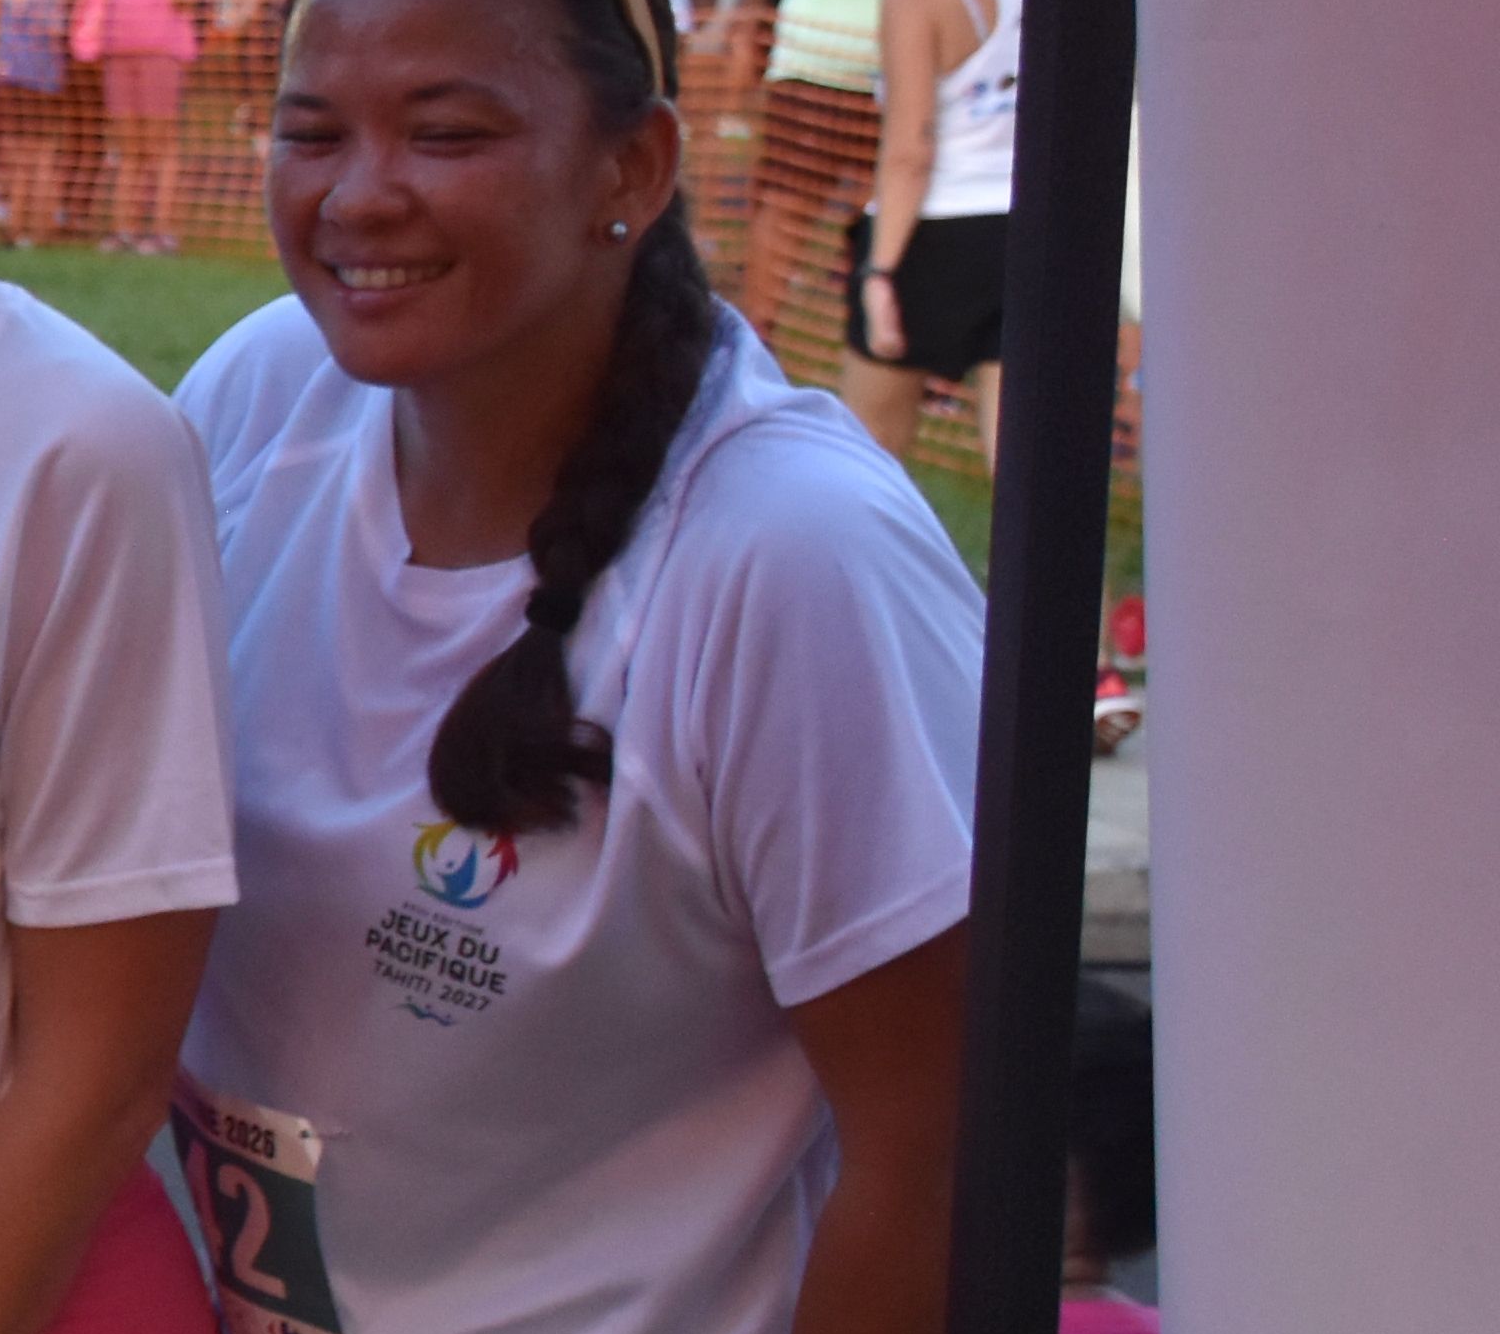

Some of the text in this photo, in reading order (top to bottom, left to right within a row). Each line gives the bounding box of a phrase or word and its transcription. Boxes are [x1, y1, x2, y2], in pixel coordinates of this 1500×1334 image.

[365, 928, 507, 995] PACIFIQUE
[381, 908, 449, 951] JEUX
[458, 936, 500, 965] DU
[438, 984, 492, 1012] 2027
